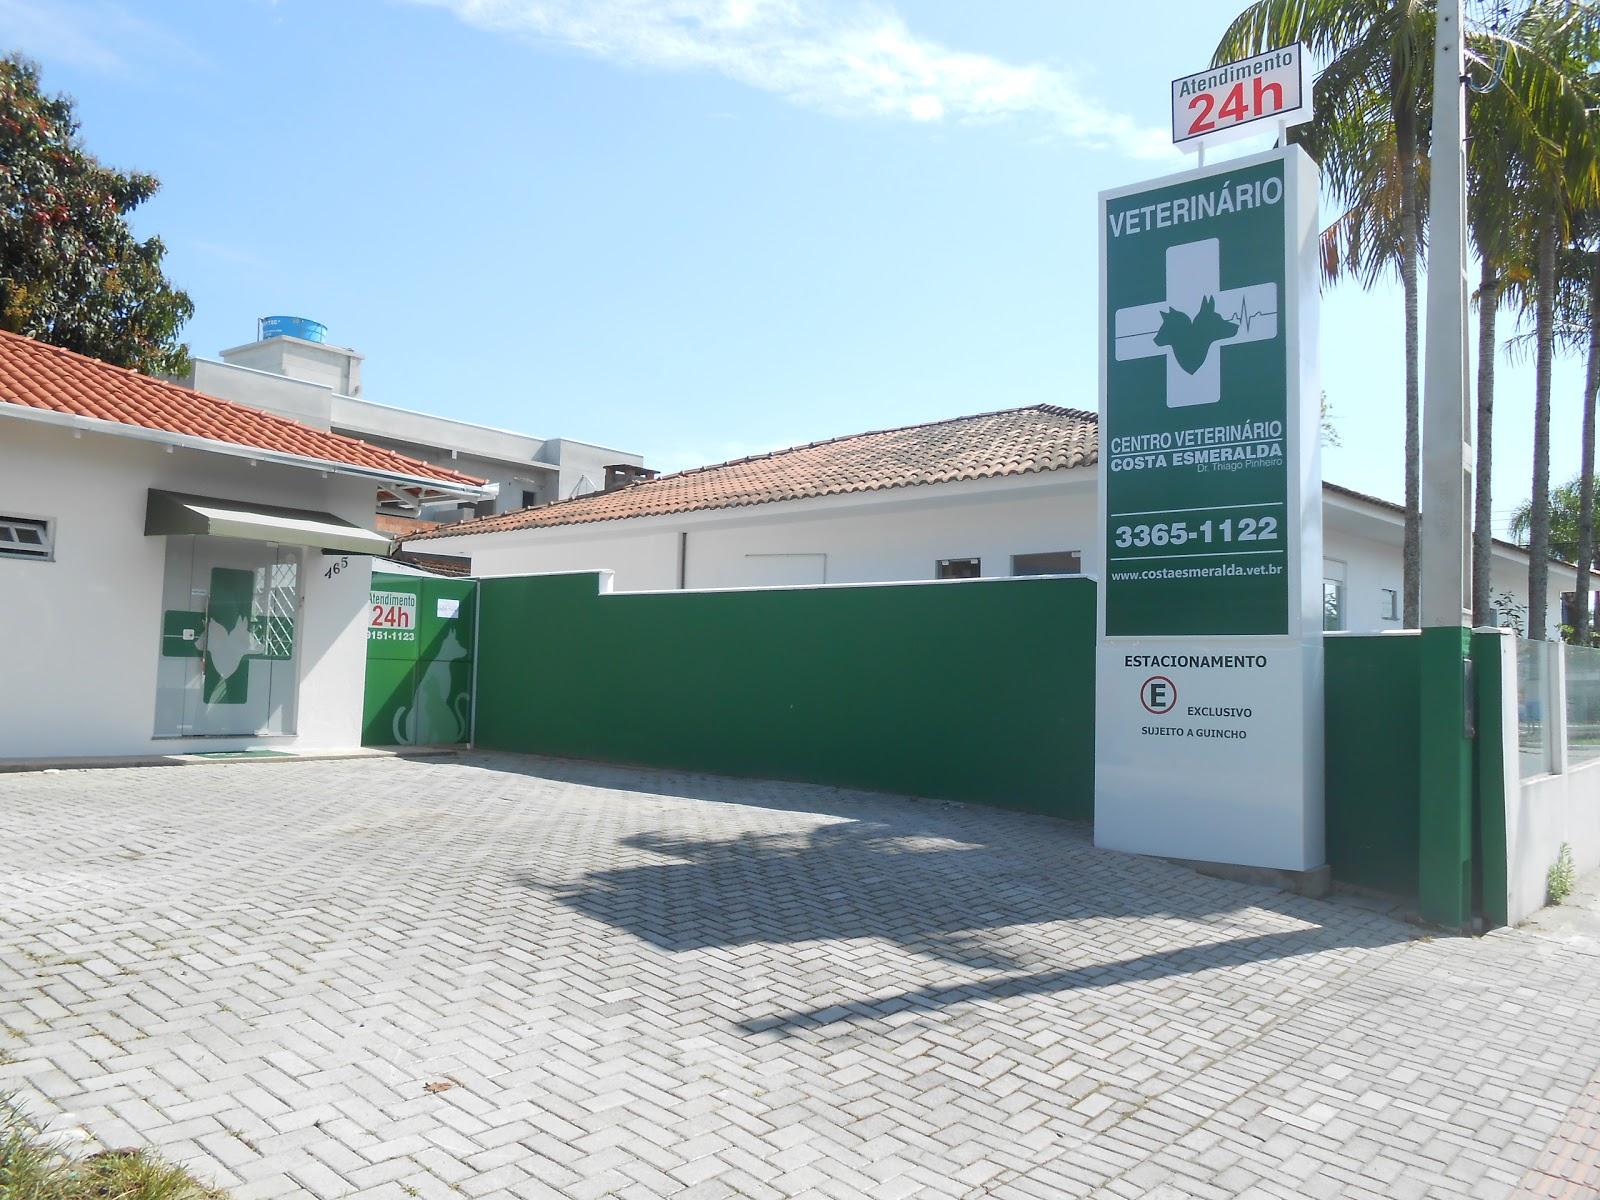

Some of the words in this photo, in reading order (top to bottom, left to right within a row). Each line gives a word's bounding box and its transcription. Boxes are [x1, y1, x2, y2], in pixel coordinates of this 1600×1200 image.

[1179, 52, 1292, 98] Atendimento
[1187, 76, 1283, 136] 24h
[1109, 176, 1283, 238] VETERINÁRIO
[1111, 432, 1172, 454] CENTRO
[1175, 419, 1282, 447] VETERINÁRIO
[1110, 454, 1167, 472] COSTA
[1172, 443, 1283, 467] ESMERALDA
[1211, 461, 1243, 472] Thiago
[1245, 458, 1283, 469] Pinheiro
[1115, 516, 1278, 548] 3365-1122
[1111, 564, 1283, 581] www.costaesmeralda.vet.br
[371, 604, 409, 628] 24h
[1124, 655, 1267, 668] ESTACIONAMENTO
[1150, 683, 1166, 707] E
[1187, 706, 1253, 718] EXCLUSIVO
[1141, 726, 1184, 737] SUJEITO
[1186, 728, 1194, 737] A
[1196, 728, 1247, 739] GUINCHO
